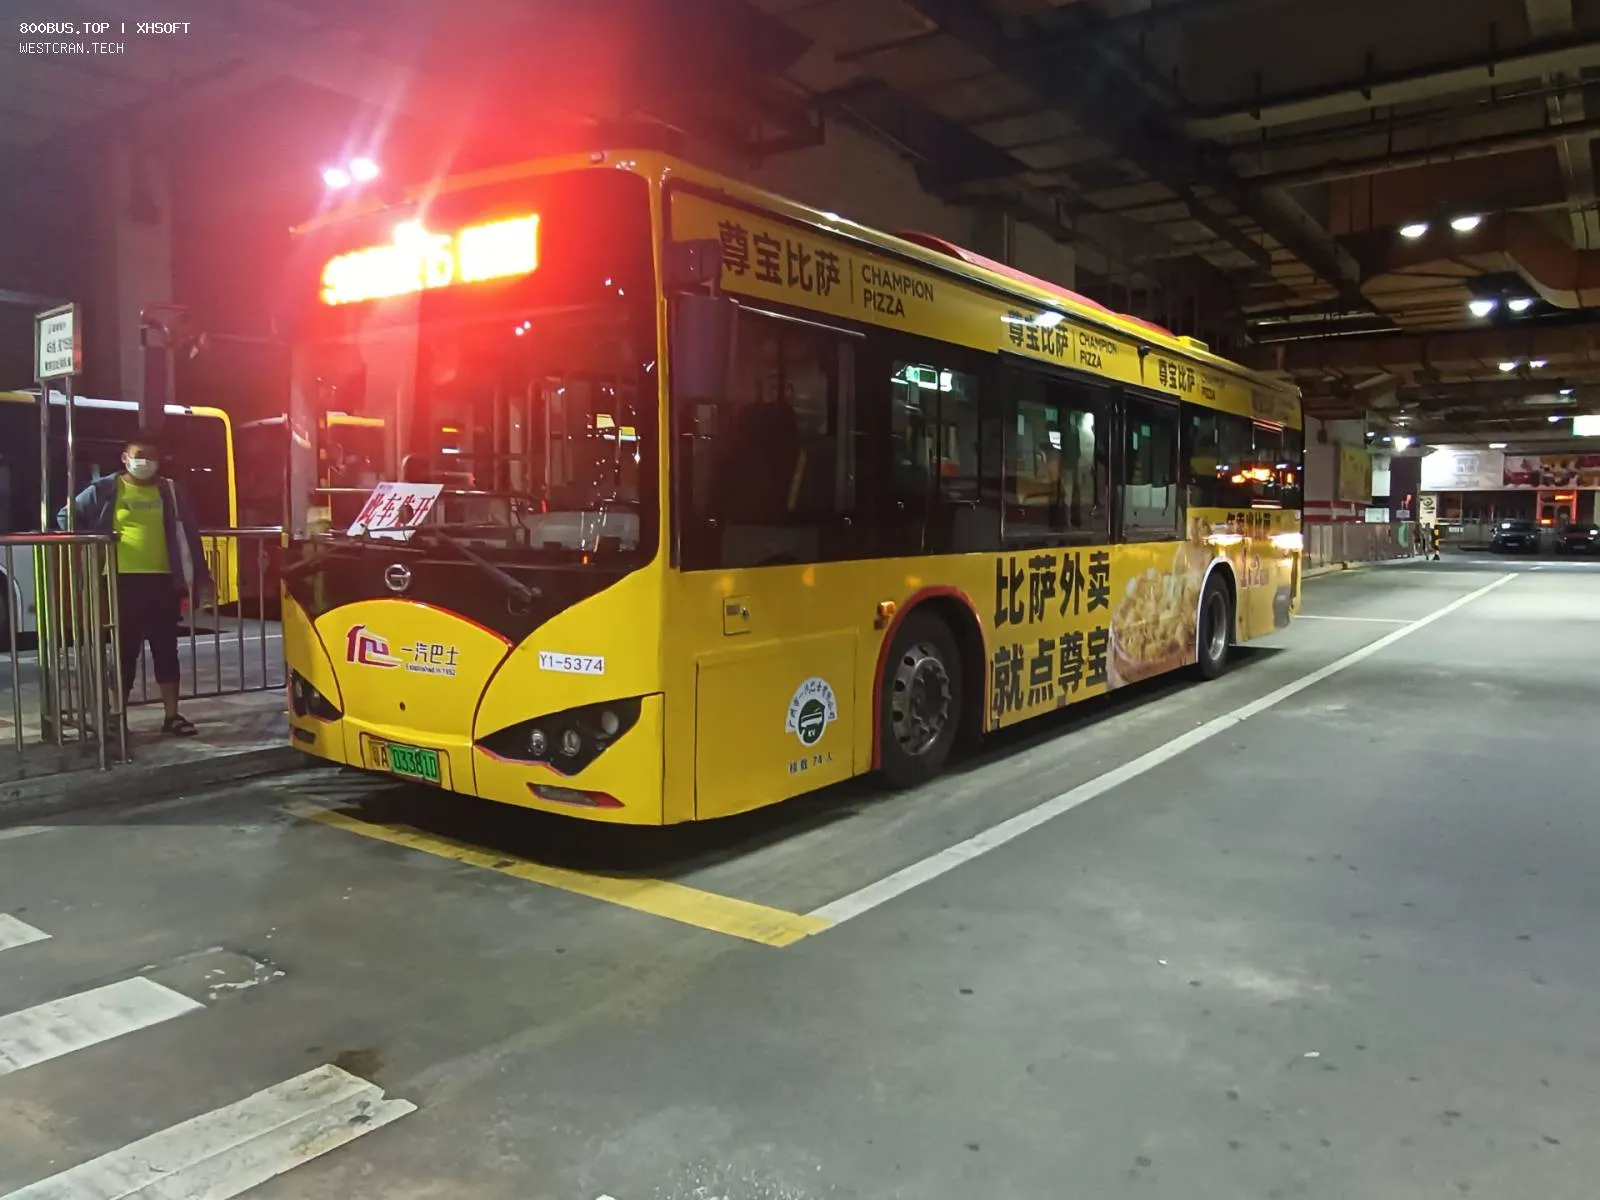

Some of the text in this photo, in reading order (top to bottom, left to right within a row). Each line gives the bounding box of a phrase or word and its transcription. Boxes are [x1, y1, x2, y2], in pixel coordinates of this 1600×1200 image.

[717, 219, 841, 297] 尊宝比萨
[861, 264, 934, 302] CHAMPION
[863, 289, 906, 318] PIZZA
[1008, 310, 1068, 358] 尊宝比萨
[1079, 331, 1118, 355] CHAMPION
[1080, 350, 1103, 369] PIZZA
[1158, 358, 1196, 393] 尊宝比萨
[993, 550, 1110, 630] 比萨外卖
[401, 641, 460, 665] 一汽巴士
[540, 653, 603, 672] Y1-5374
[991, 625, 1110, 715] 就点尊宝
